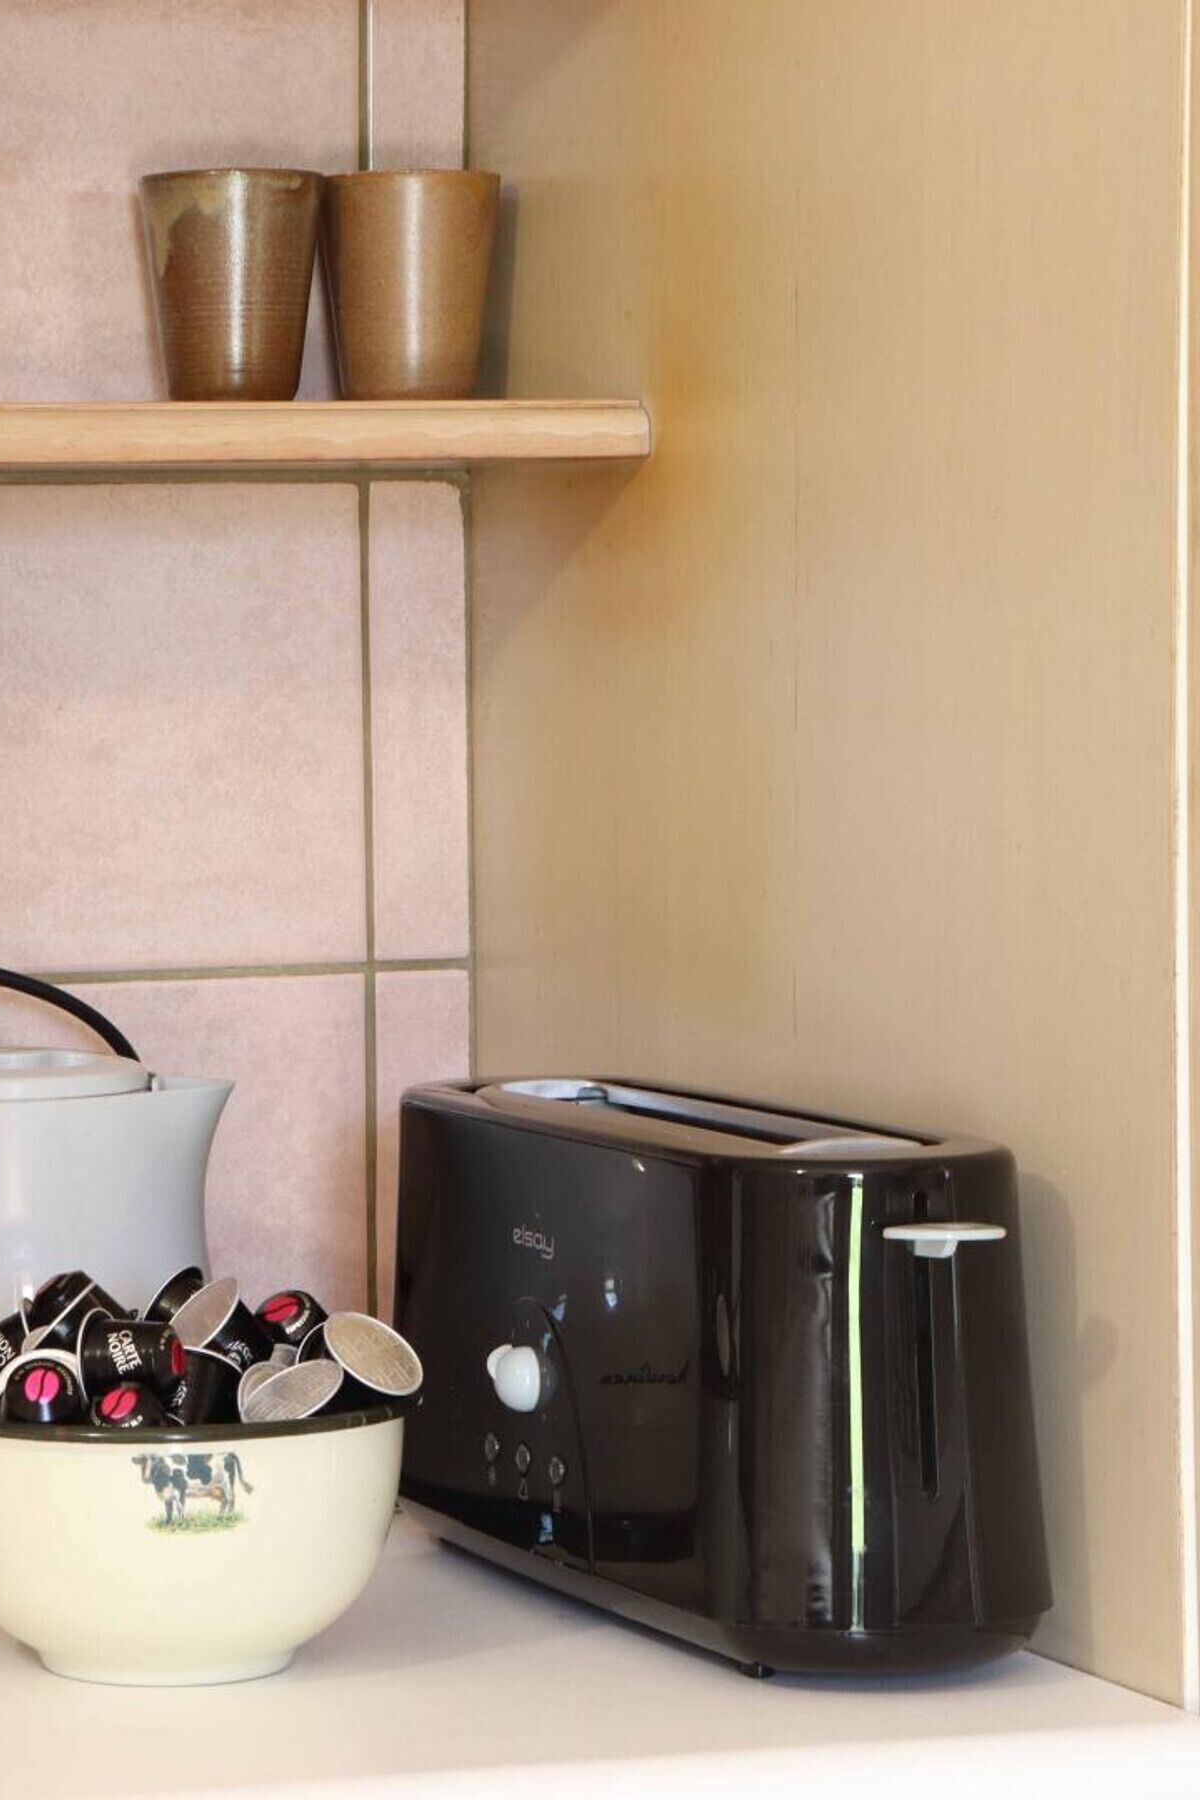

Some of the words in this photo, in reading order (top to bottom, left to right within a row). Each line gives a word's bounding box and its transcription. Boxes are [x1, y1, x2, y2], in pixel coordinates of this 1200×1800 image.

[513, 1224, 555, 1260] elsay
[107, 1332, 129, 1375] NOIRE
[119, 1330, 143, 1372] CARTE
